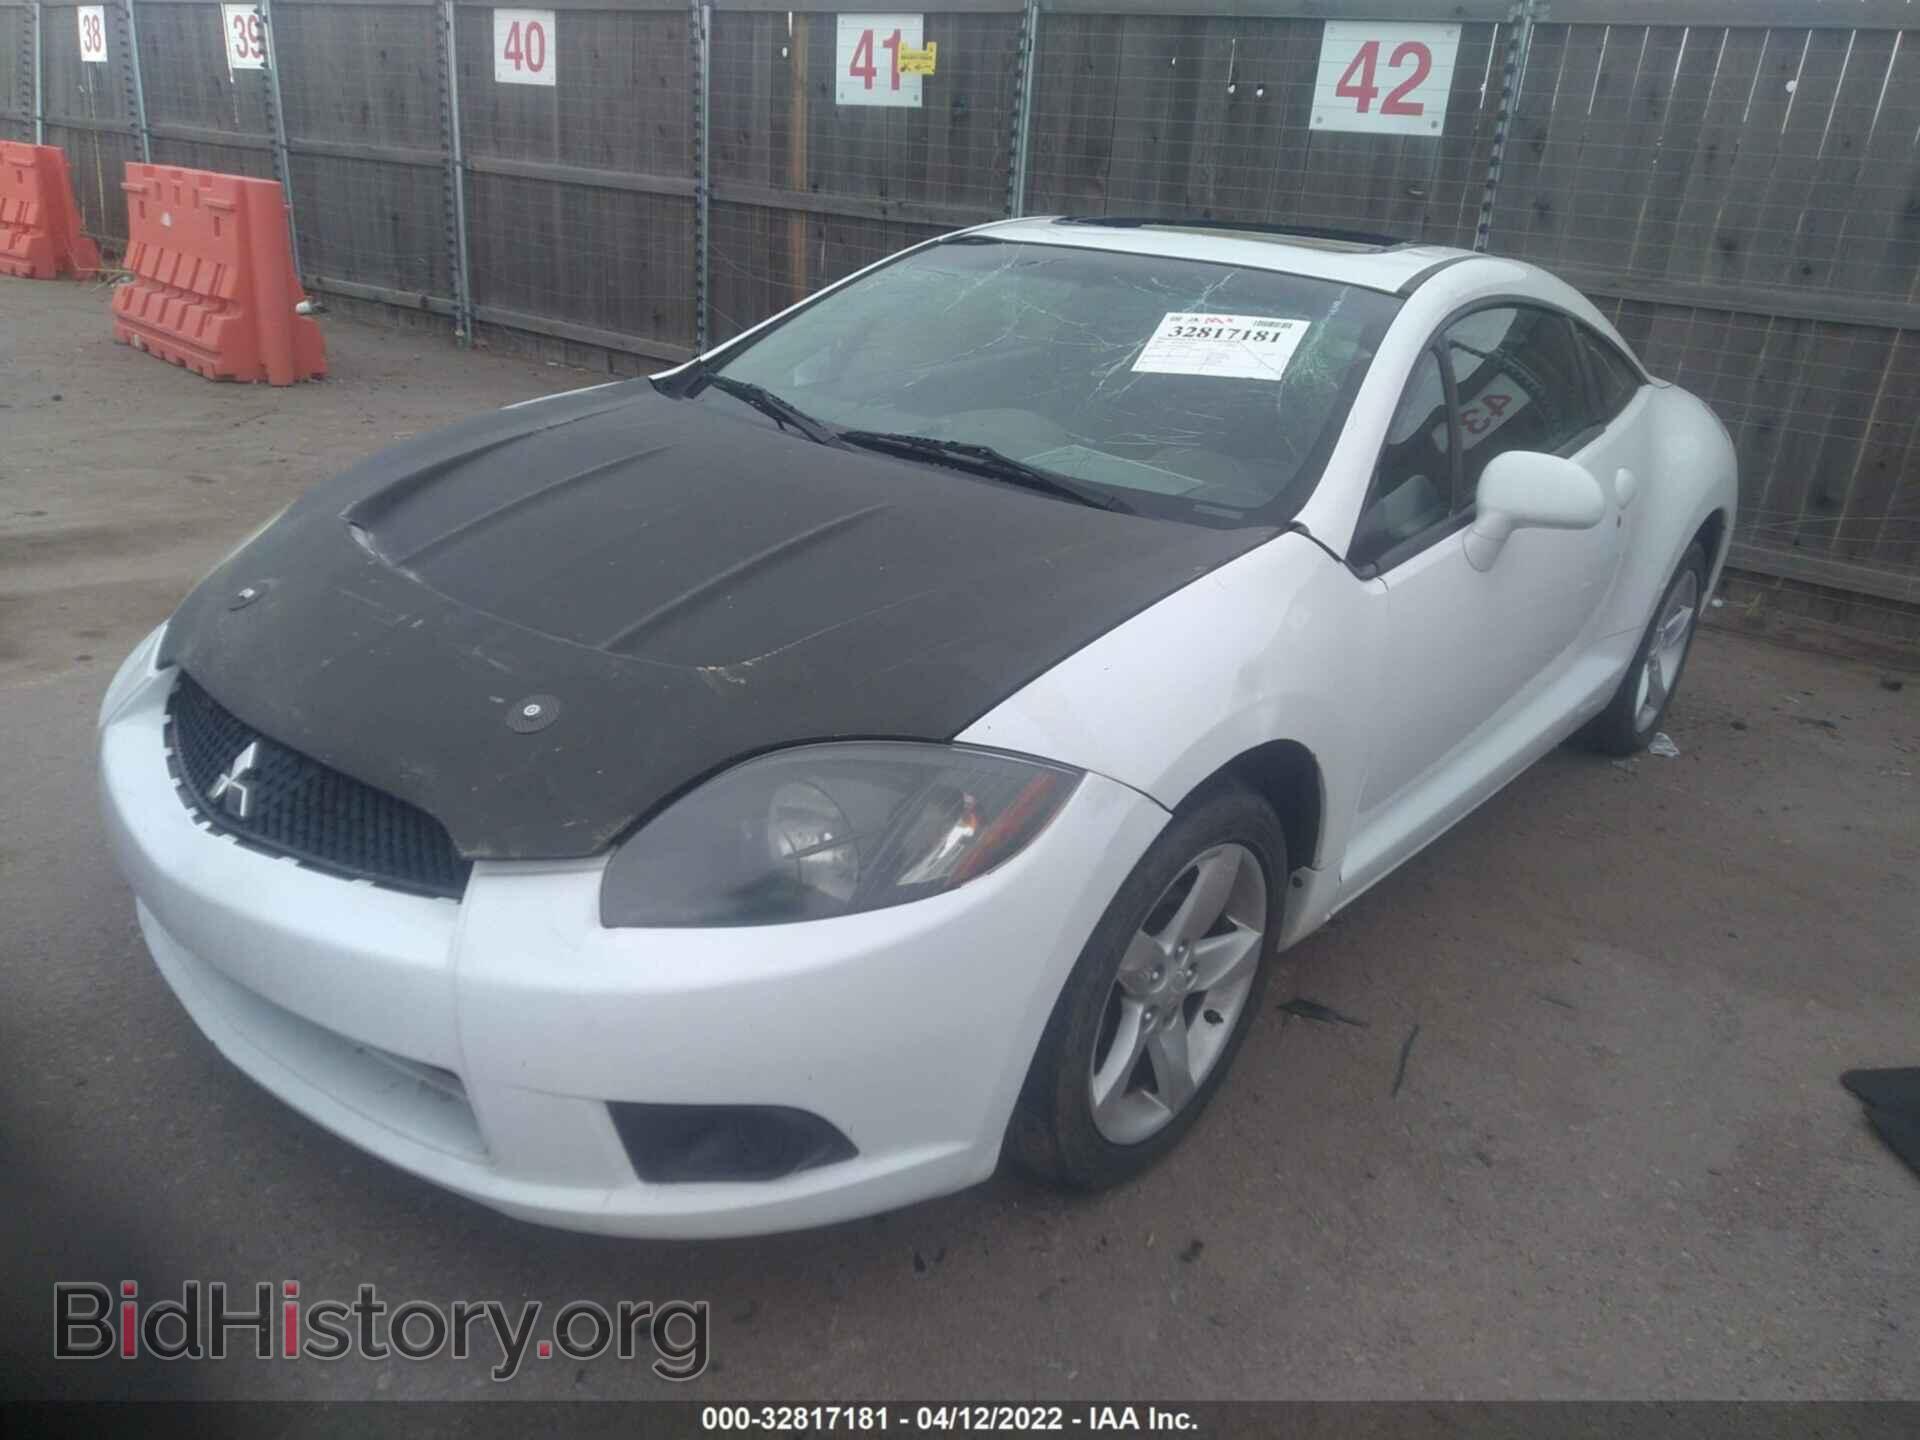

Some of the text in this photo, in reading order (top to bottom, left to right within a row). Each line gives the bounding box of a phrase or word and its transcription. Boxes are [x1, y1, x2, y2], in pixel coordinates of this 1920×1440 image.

[83, 15, 102, 52] 38
[233, 15, 262, 58] 39
[504, 20, 545, 73] 40
[849, 28, 901, 91] 41
[1335, 40, 1432, 116] 42
[1167, 326, 1281, 343] 32817181
